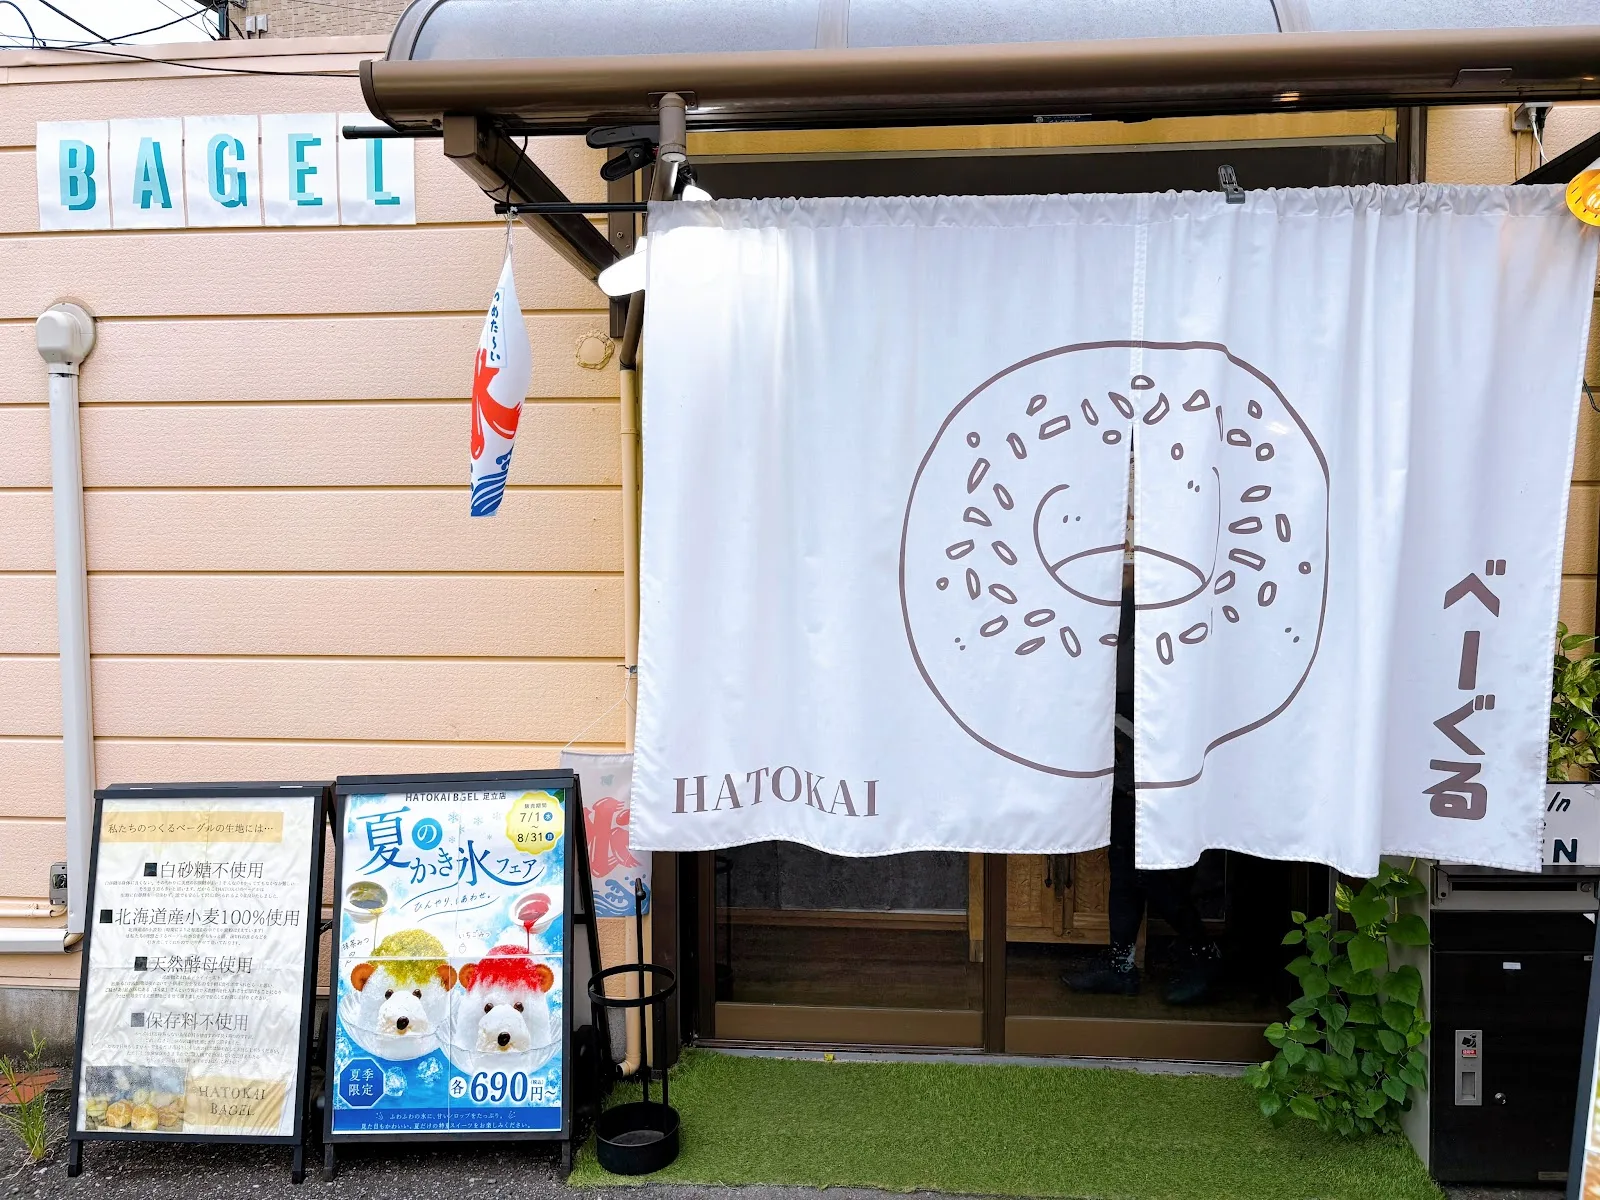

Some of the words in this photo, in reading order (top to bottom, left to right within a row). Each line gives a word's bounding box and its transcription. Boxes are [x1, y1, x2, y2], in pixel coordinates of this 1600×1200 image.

[60, 132, 400, 211] BAGEL
[405, 792, 450, 802] HATOKAI
[453, 792, 479, 802] BGEL
[483, 791, 507, 800] 足立店
[672, 766, 880, 817] HATOKAI
[519, 812, 540, 823] 7/1
[517, 832, 543, 843] 8/31
[160, 861, 264, 879] 白砂糖不使用
[114, 908, 300, 926] 北海道産小麦100%使用
[150, 955, 253, 974] 天然酵母使用
[145, 1012, 249, 1031] 保存料不使用
[348, 1068, 374, 1081] 夏季
[199, 1086, 266, 1100] HATOKAI
[348, 1084, 374, 1097] 限定
[451, 1079, 464, 1095] 各
[210, 1103, 255, 1116] BAGEL
